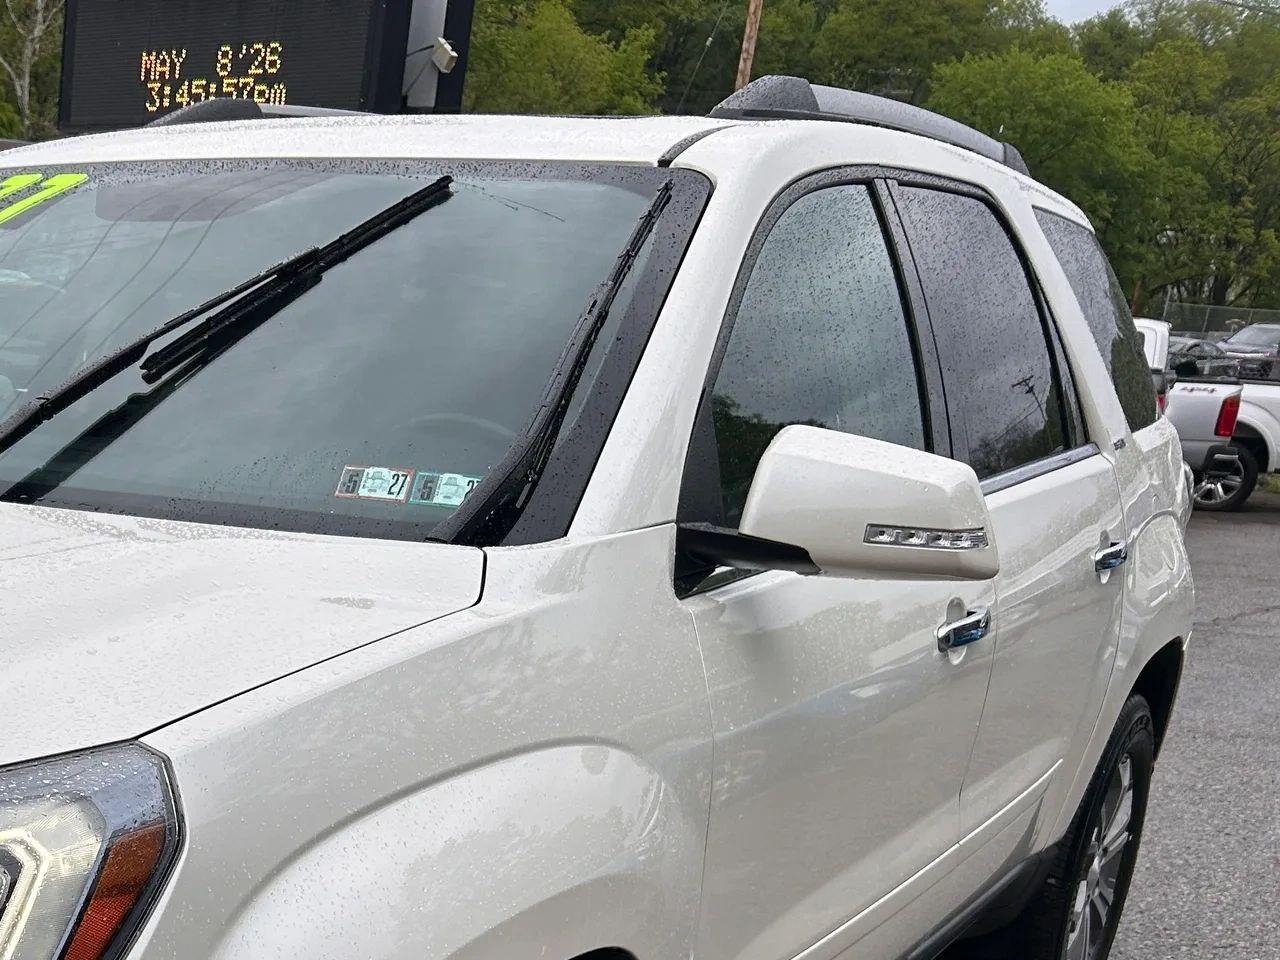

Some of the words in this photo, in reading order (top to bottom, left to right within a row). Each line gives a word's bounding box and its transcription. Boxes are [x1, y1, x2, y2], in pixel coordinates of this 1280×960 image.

[141, 49, 187, 81] MAY
[344, 472, 359, 493] 5
[387, 474, 408, 496] 27
